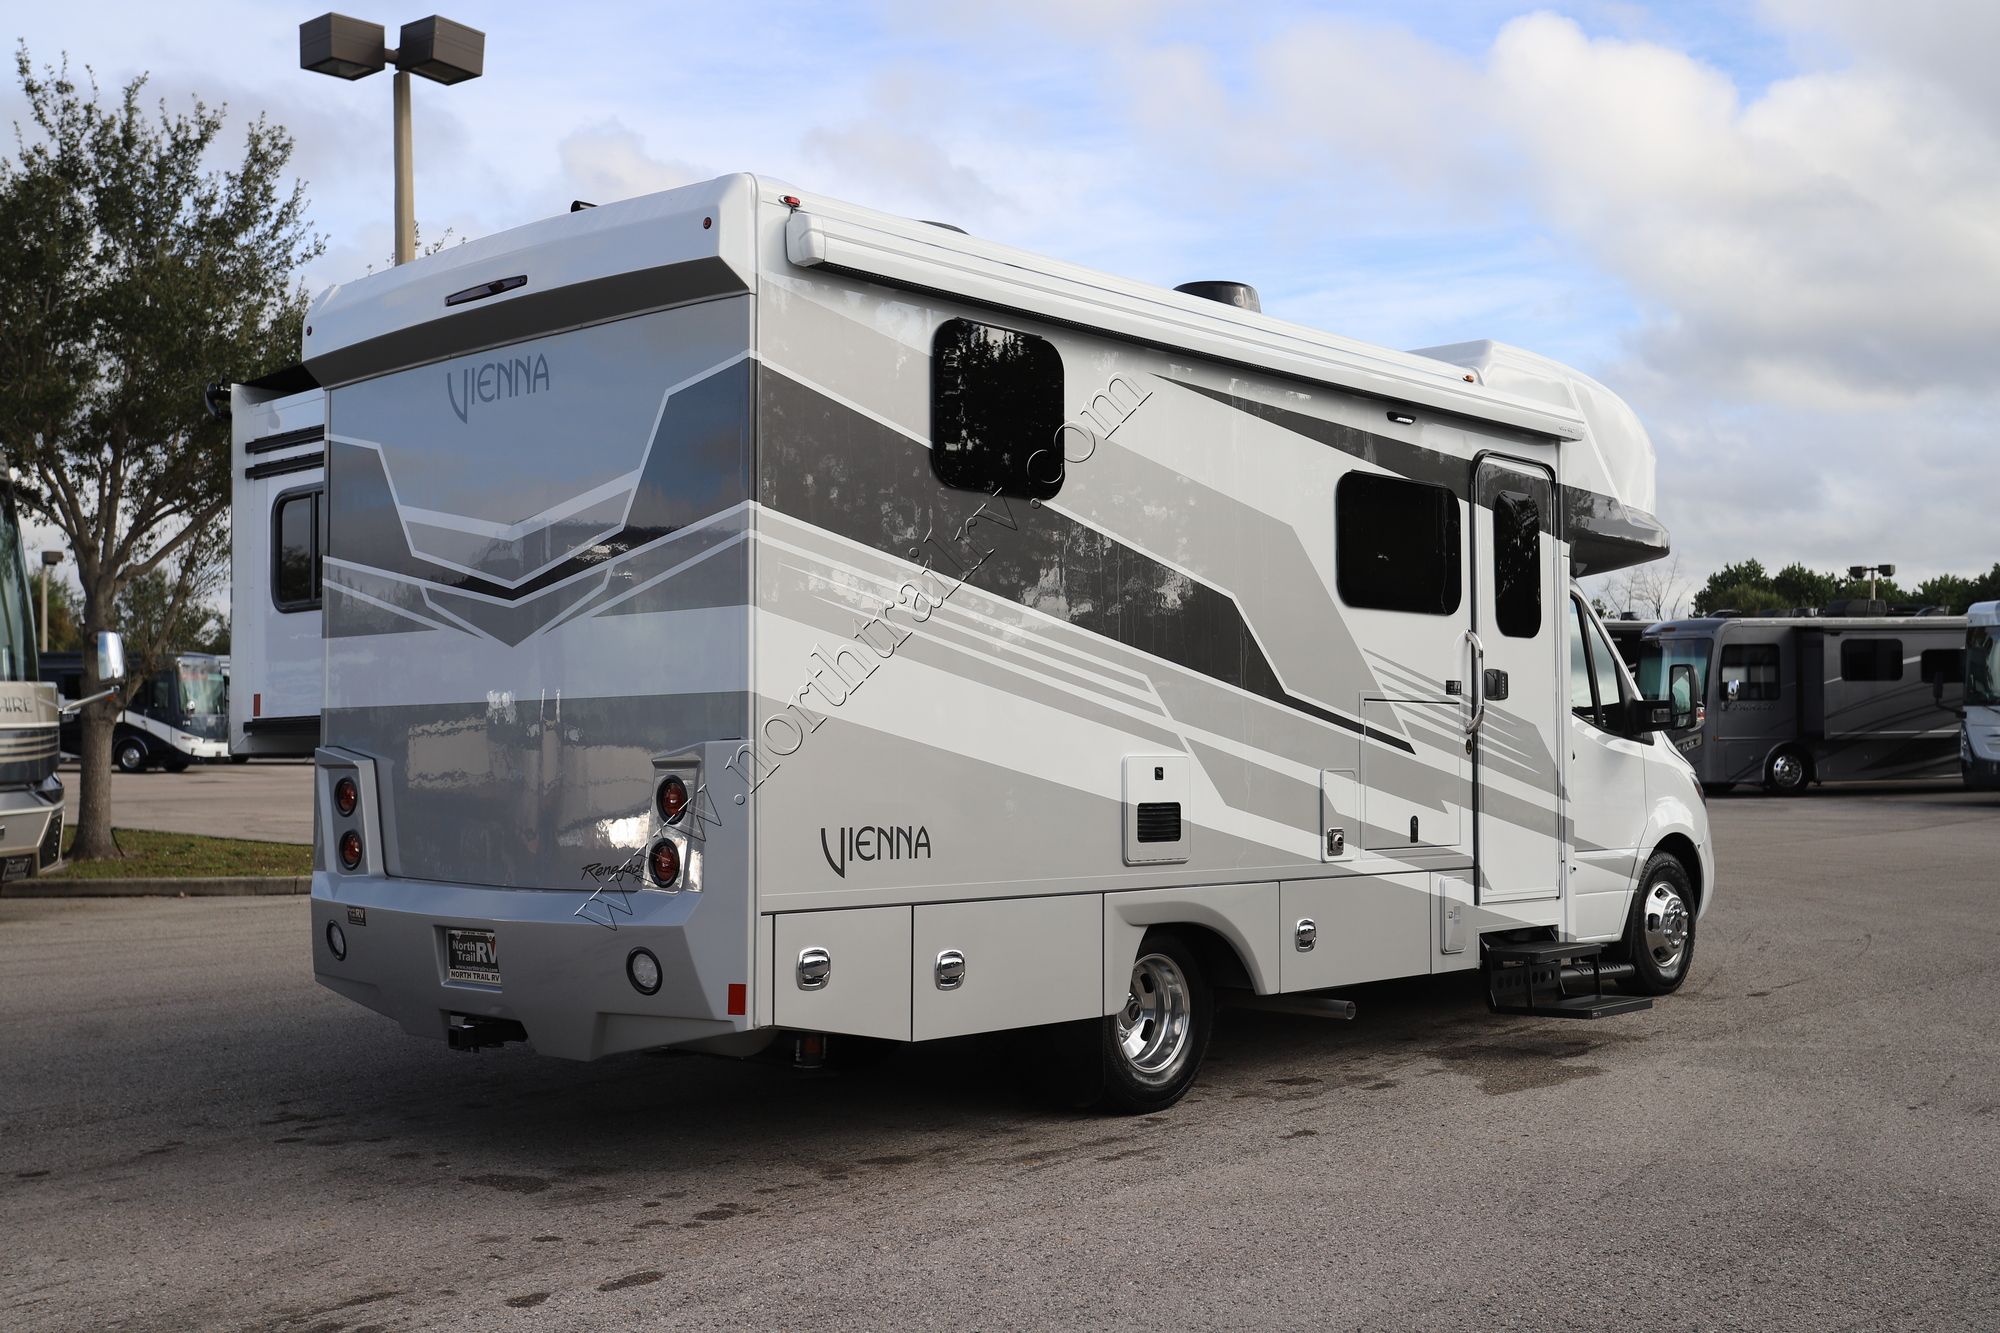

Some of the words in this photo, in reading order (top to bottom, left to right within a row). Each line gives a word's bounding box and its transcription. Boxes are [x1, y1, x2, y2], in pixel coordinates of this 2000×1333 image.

[447, 353, 550, 424] VIENNA
[820, 825, 931, 879] VIENNA
[452, 940, 476, 951] North
[476, 942, 497, 963] RV
[457, 951, 476, 962] Trail
[451, 971, 471, 979] NORTH
[472, 973, 490, 981] TRAIL
[491, 974, 500, 982] RV
